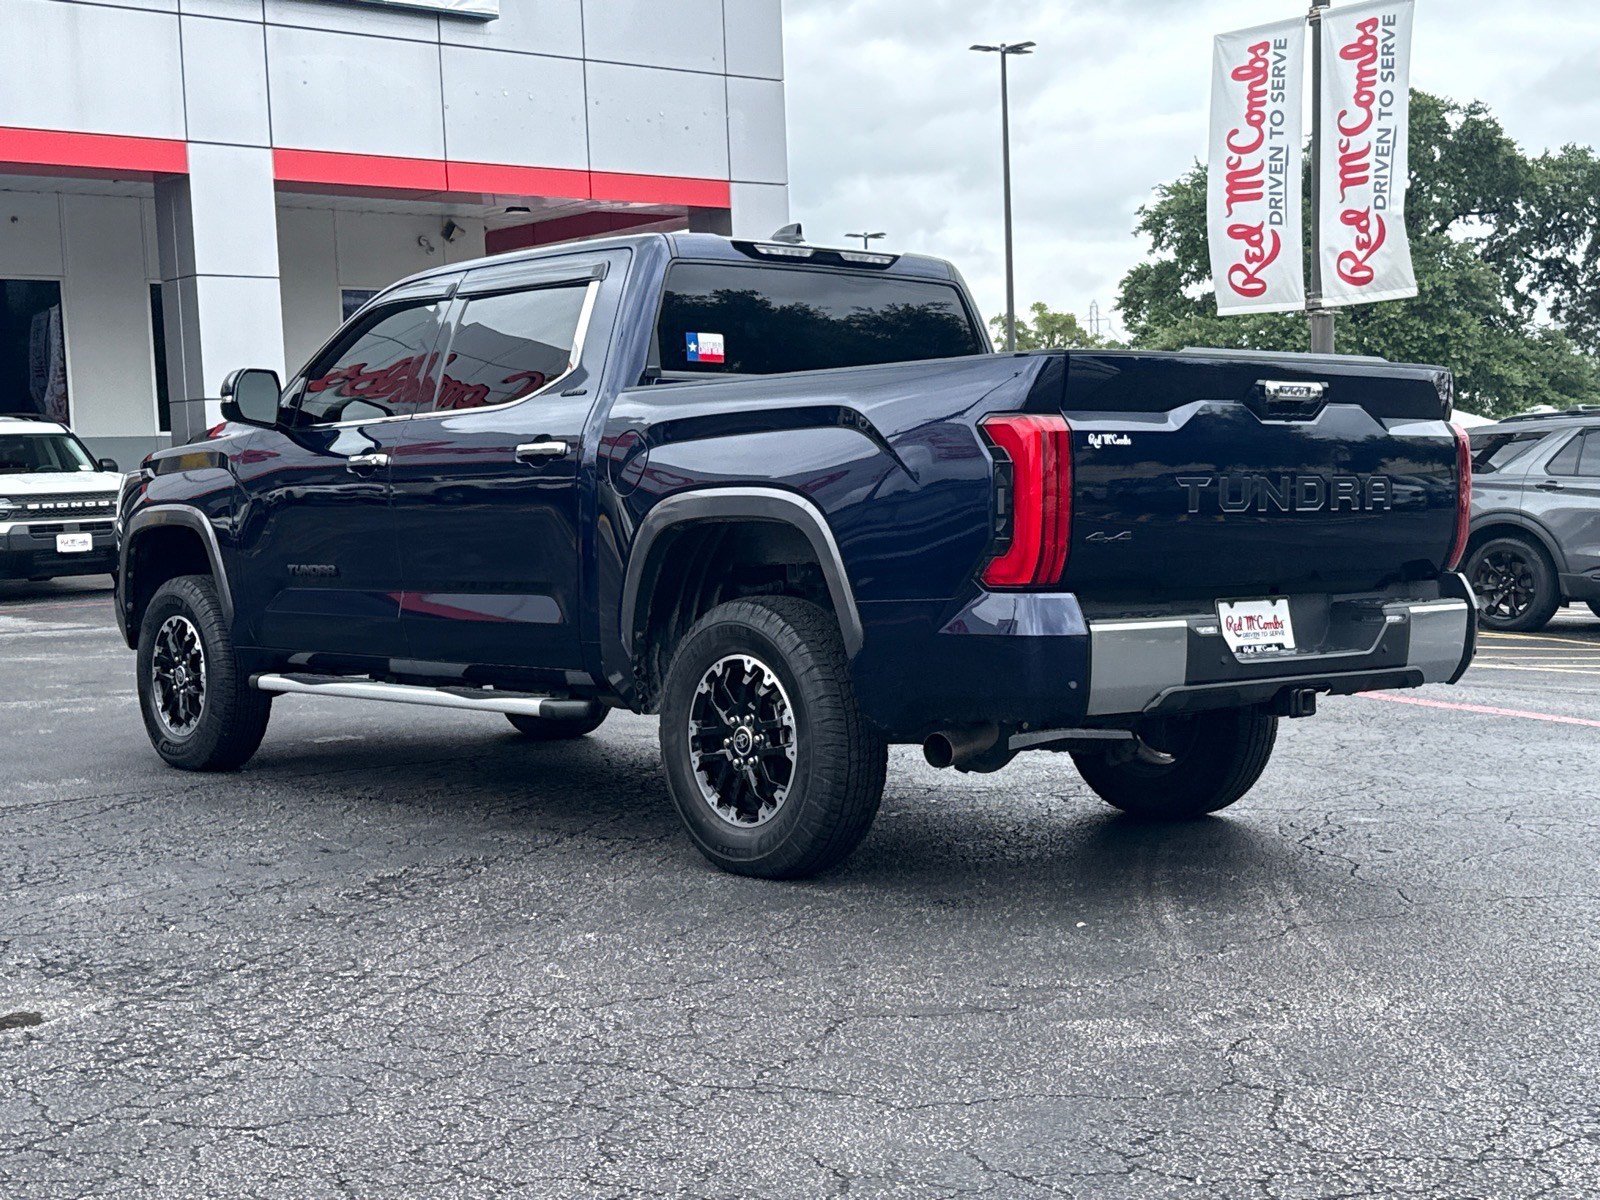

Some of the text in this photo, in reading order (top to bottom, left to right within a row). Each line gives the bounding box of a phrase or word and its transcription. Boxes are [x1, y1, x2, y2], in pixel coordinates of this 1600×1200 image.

[1373, 14, 1397, 211] DRIVEN TO SERVE
[1268, 37, 1288, 226] DRIVEN TO SERVE
[1227, 220, 1281, 298] Red
[1336, 205, 1386, 287] Red
[1088, 433, 1102, 449] Red
[27, 500, 110, 509] BRONCO
[1175, 475, 1392, 513] TUNDRA
[287, 564, 336, 575] TUNDRA
[1225, 615, 1243, 638] Red
[1269, 629, 1286, 637] SERVE
